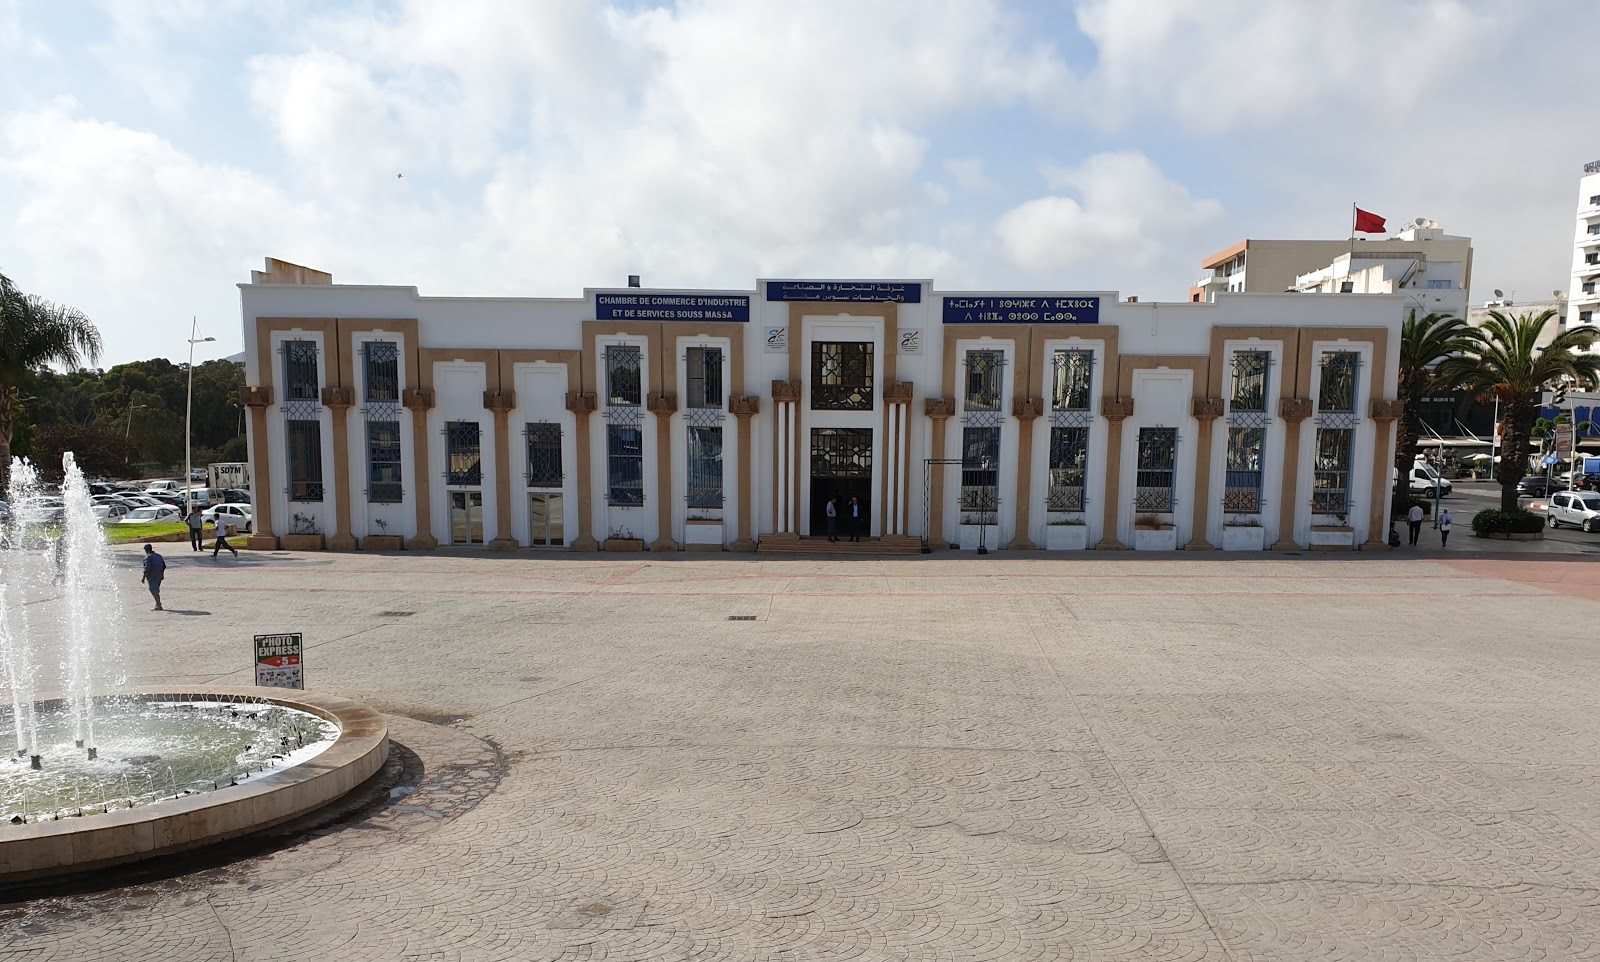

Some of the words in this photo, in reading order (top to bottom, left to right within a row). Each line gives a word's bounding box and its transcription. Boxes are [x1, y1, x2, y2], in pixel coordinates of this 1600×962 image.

[833, 283, 875, 292] التجارة
[876, 283, 905, 292] غرفة
[599, 296, 638, 305] CHAMBRE
[639, 296, 650, 306] DE
[651, 297, 696, 306] COMMERCE
[697, 298, 747, 307] D'INDUSTRIE
[822, 294, 850, 302] سوس
[851, 293, 905, 302] والخدمات
[612, 309, 622, 317] ET
[624, 309, 635, 318] DE
[636, 310, 675, 318] SERVICES
[676, 310, 703, 319] SOUSS
[704, 310, 733, 319] MASSA
[220, 466, 241, 474] SDTM
[262, 636, 293, 647] PHOTO
[258, 645, 299, 657] EXPRESS
[281, 657, 289, 665] 5
